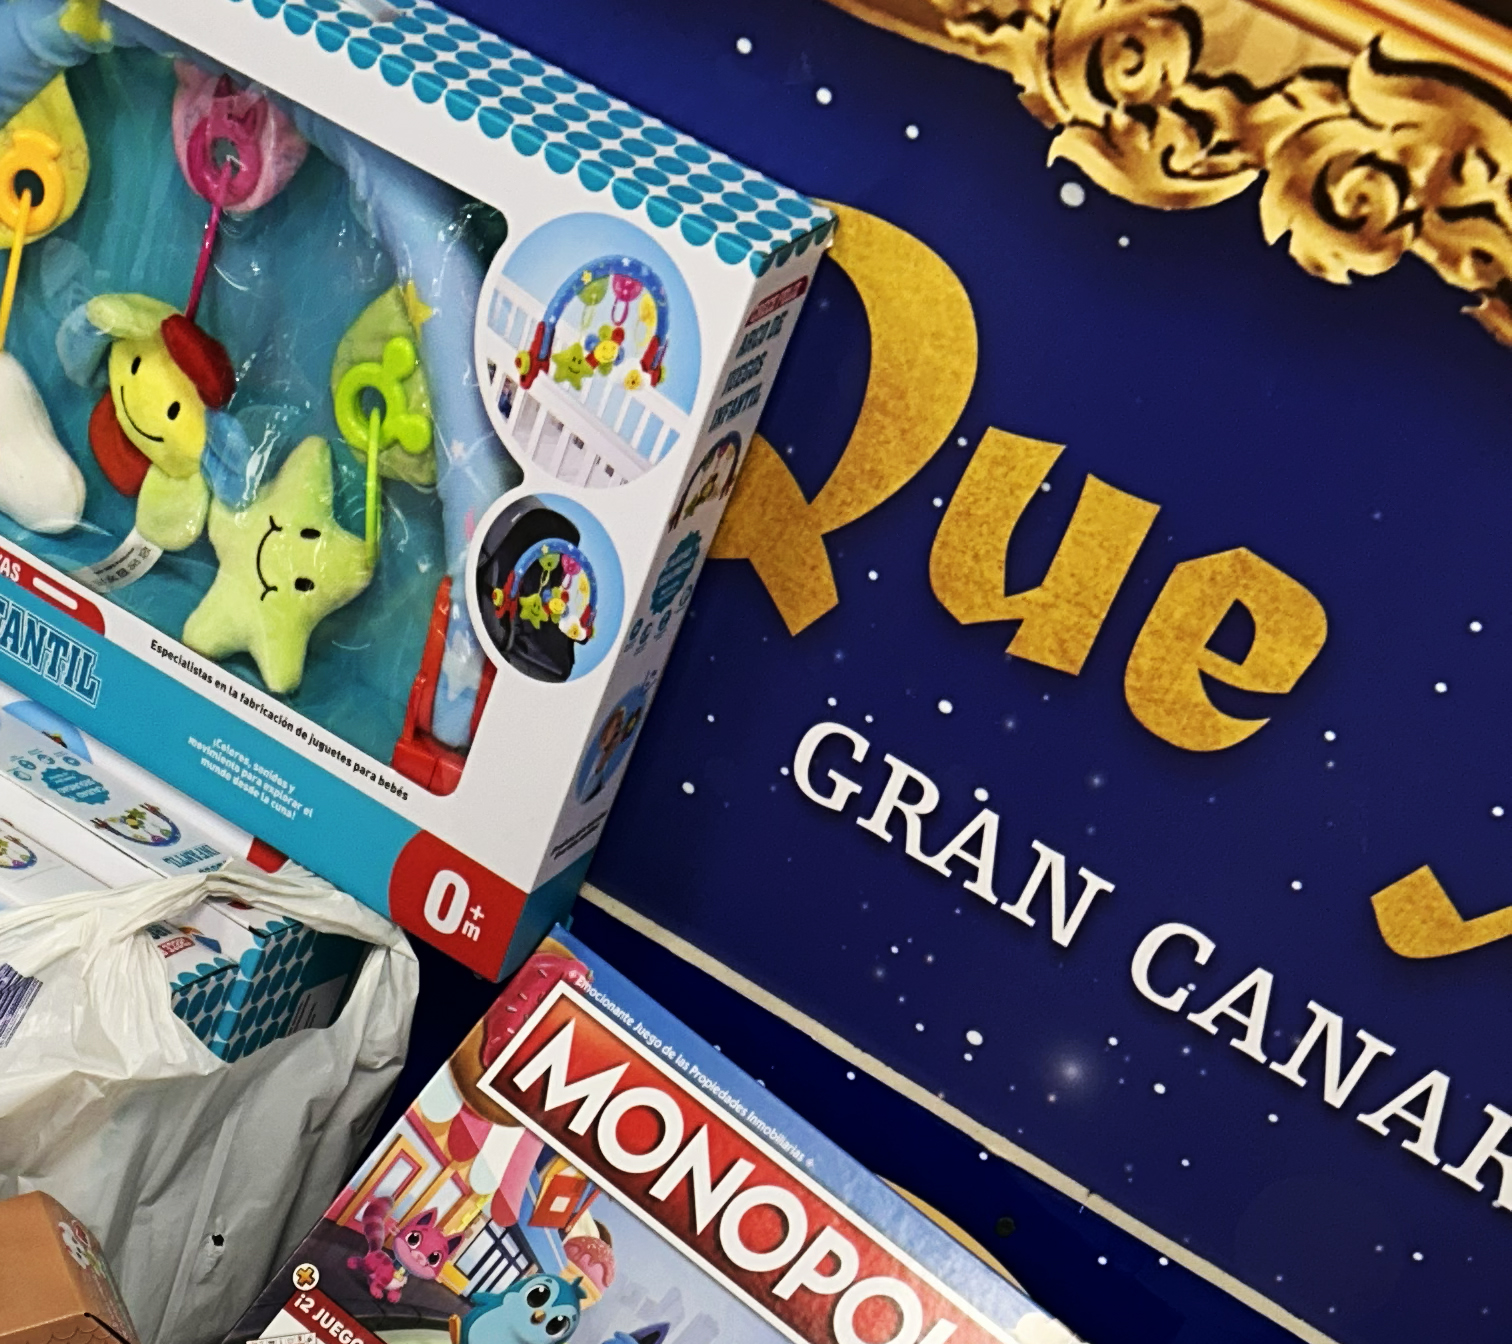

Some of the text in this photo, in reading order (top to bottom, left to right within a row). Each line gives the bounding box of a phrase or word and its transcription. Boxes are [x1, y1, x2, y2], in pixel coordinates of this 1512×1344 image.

[707, 197, 1328, 752] Que
[150, 639, 409, 801] Especialistas en la fabricación de juguetes para bebés
[792, 721, 1115, 948] GRAN
[574, 974, 805, 1164] Emocionante Juego de las Propiedades Inmobiliarias
